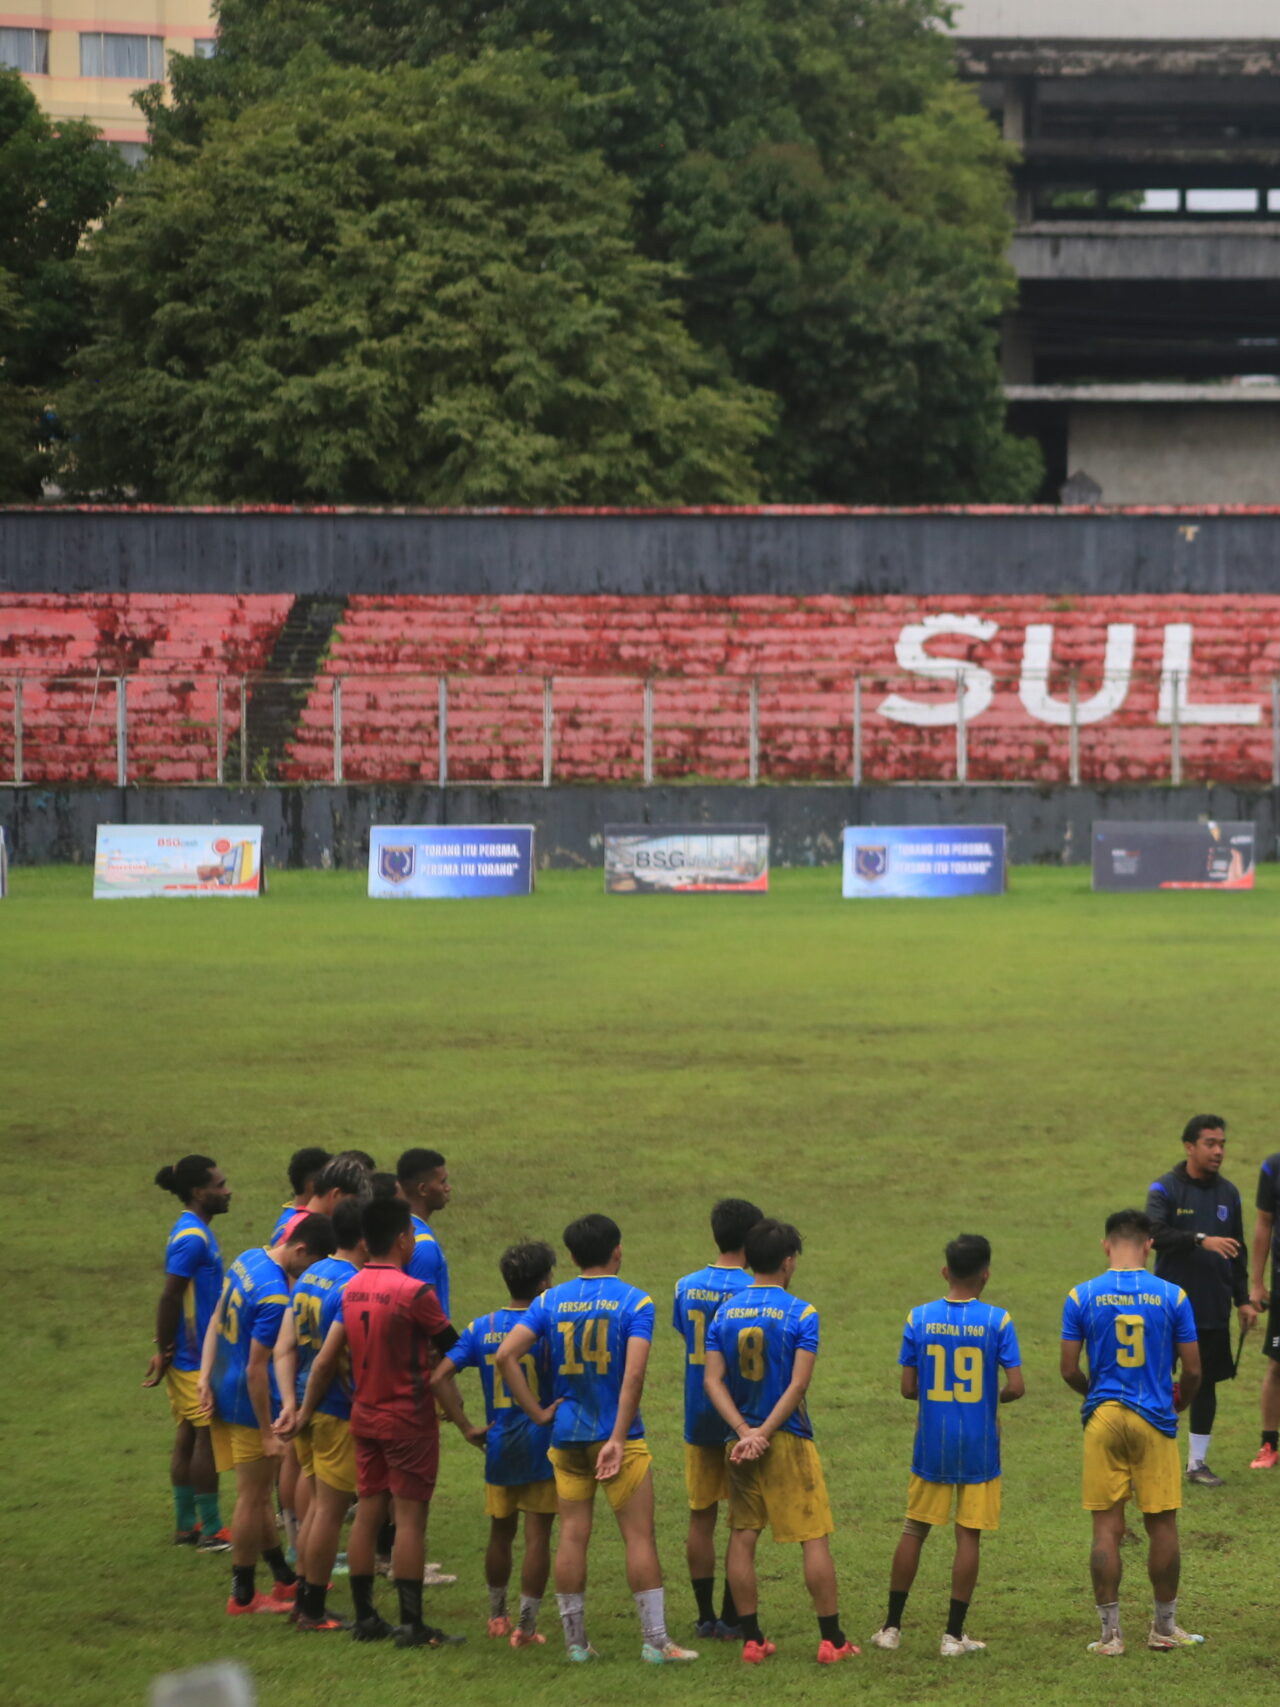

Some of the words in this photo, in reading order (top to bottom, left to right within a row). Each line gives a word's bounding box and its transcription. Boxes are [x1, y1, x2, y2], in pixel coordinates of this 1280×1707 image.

[687, 1288, 719, 1302] PERSMA
[1095, 1295, 1136, 1307] PERSMA
[1138, 1294, 1161, 1306] 1960
[558, 1301, 592, 1313] PERSMA
[595, 1299, 619, 1312] 1960
[726, 1308, 758, 1320] PERSMA
[762, 1307, 784, 1320] 1960
[926, 1323, 960, 1337] PERSMA
[962, 1324, 985, 1337] 1960
[557, 1319, 611, 1375] 14
[1115, 1314, 1146, 1368] 9
[738, 1326, 764, 1382] 8
[926, 1344, 984, 1403] 19
